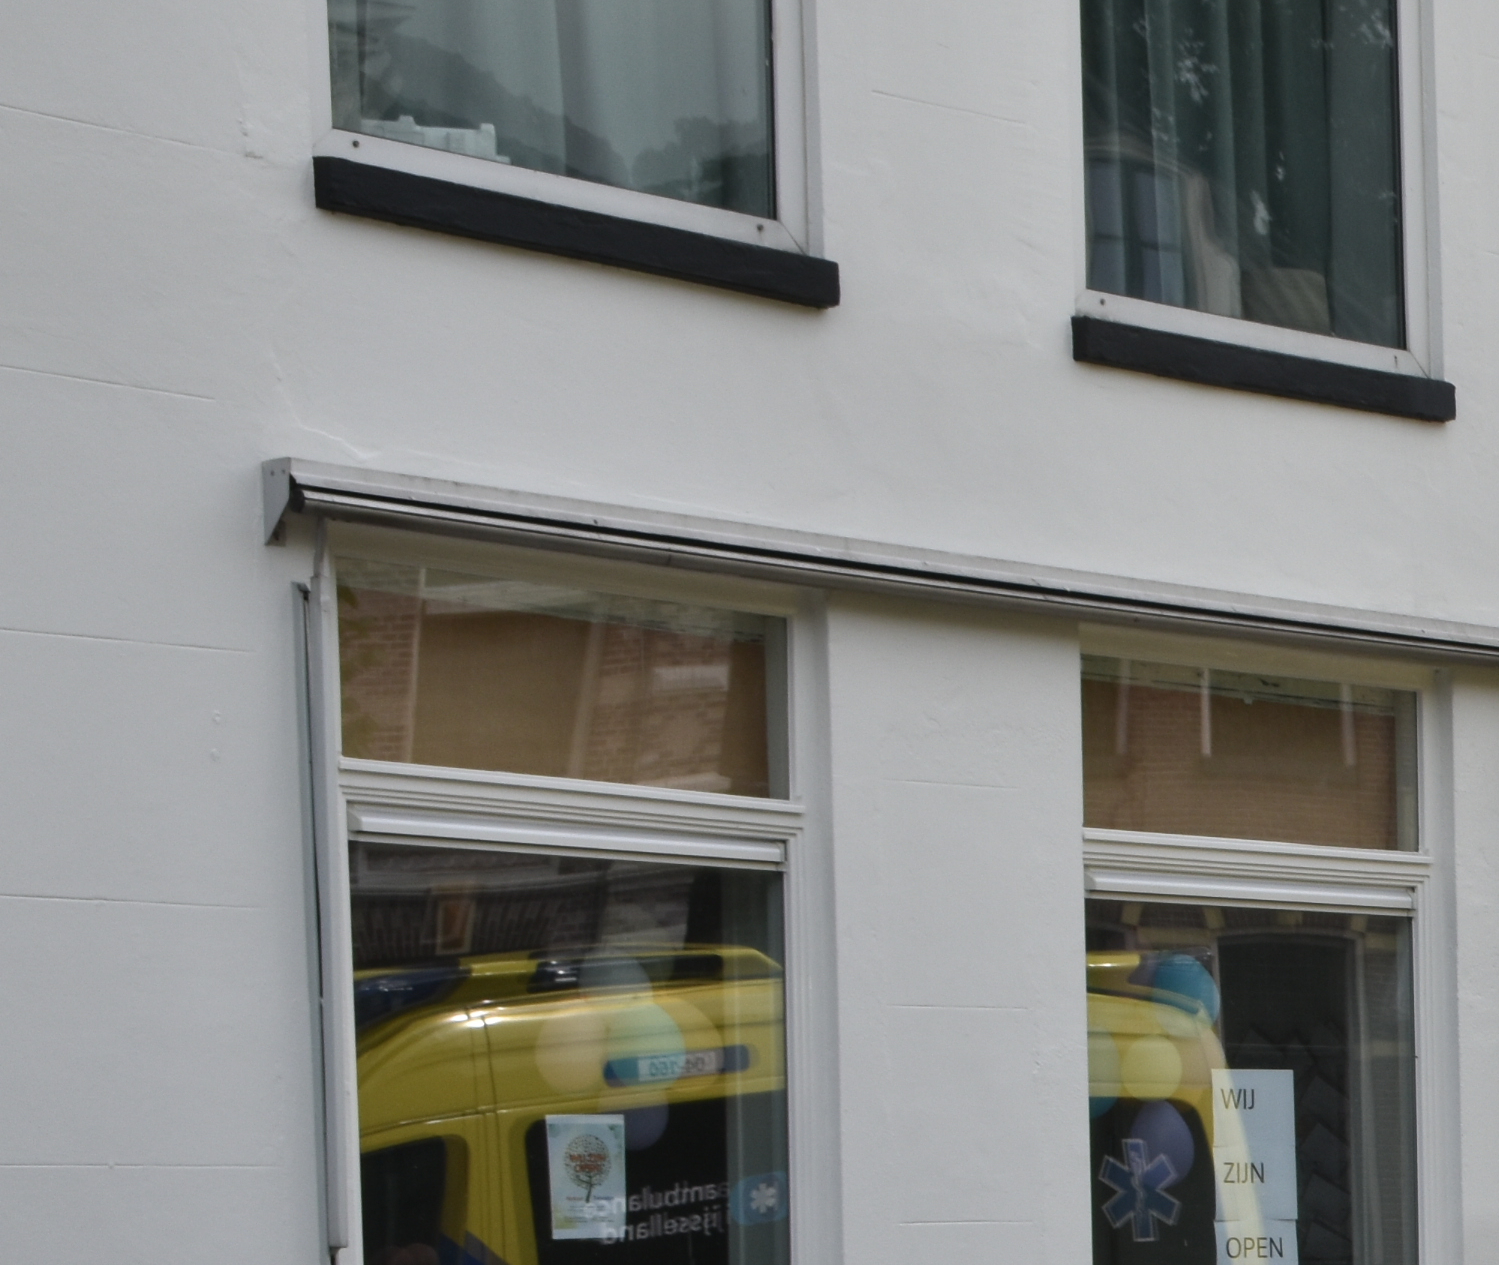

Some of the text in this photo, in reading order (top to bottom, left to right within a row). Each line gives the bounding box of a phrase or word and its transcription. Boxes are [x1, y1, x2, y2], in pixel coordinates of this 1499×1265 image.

[1221, 1088, 1256, 1110] WIJ
[1223, 1162, 1265, 1184] ZIJN
[1226, 1236, 1284, 1259] OPEN
